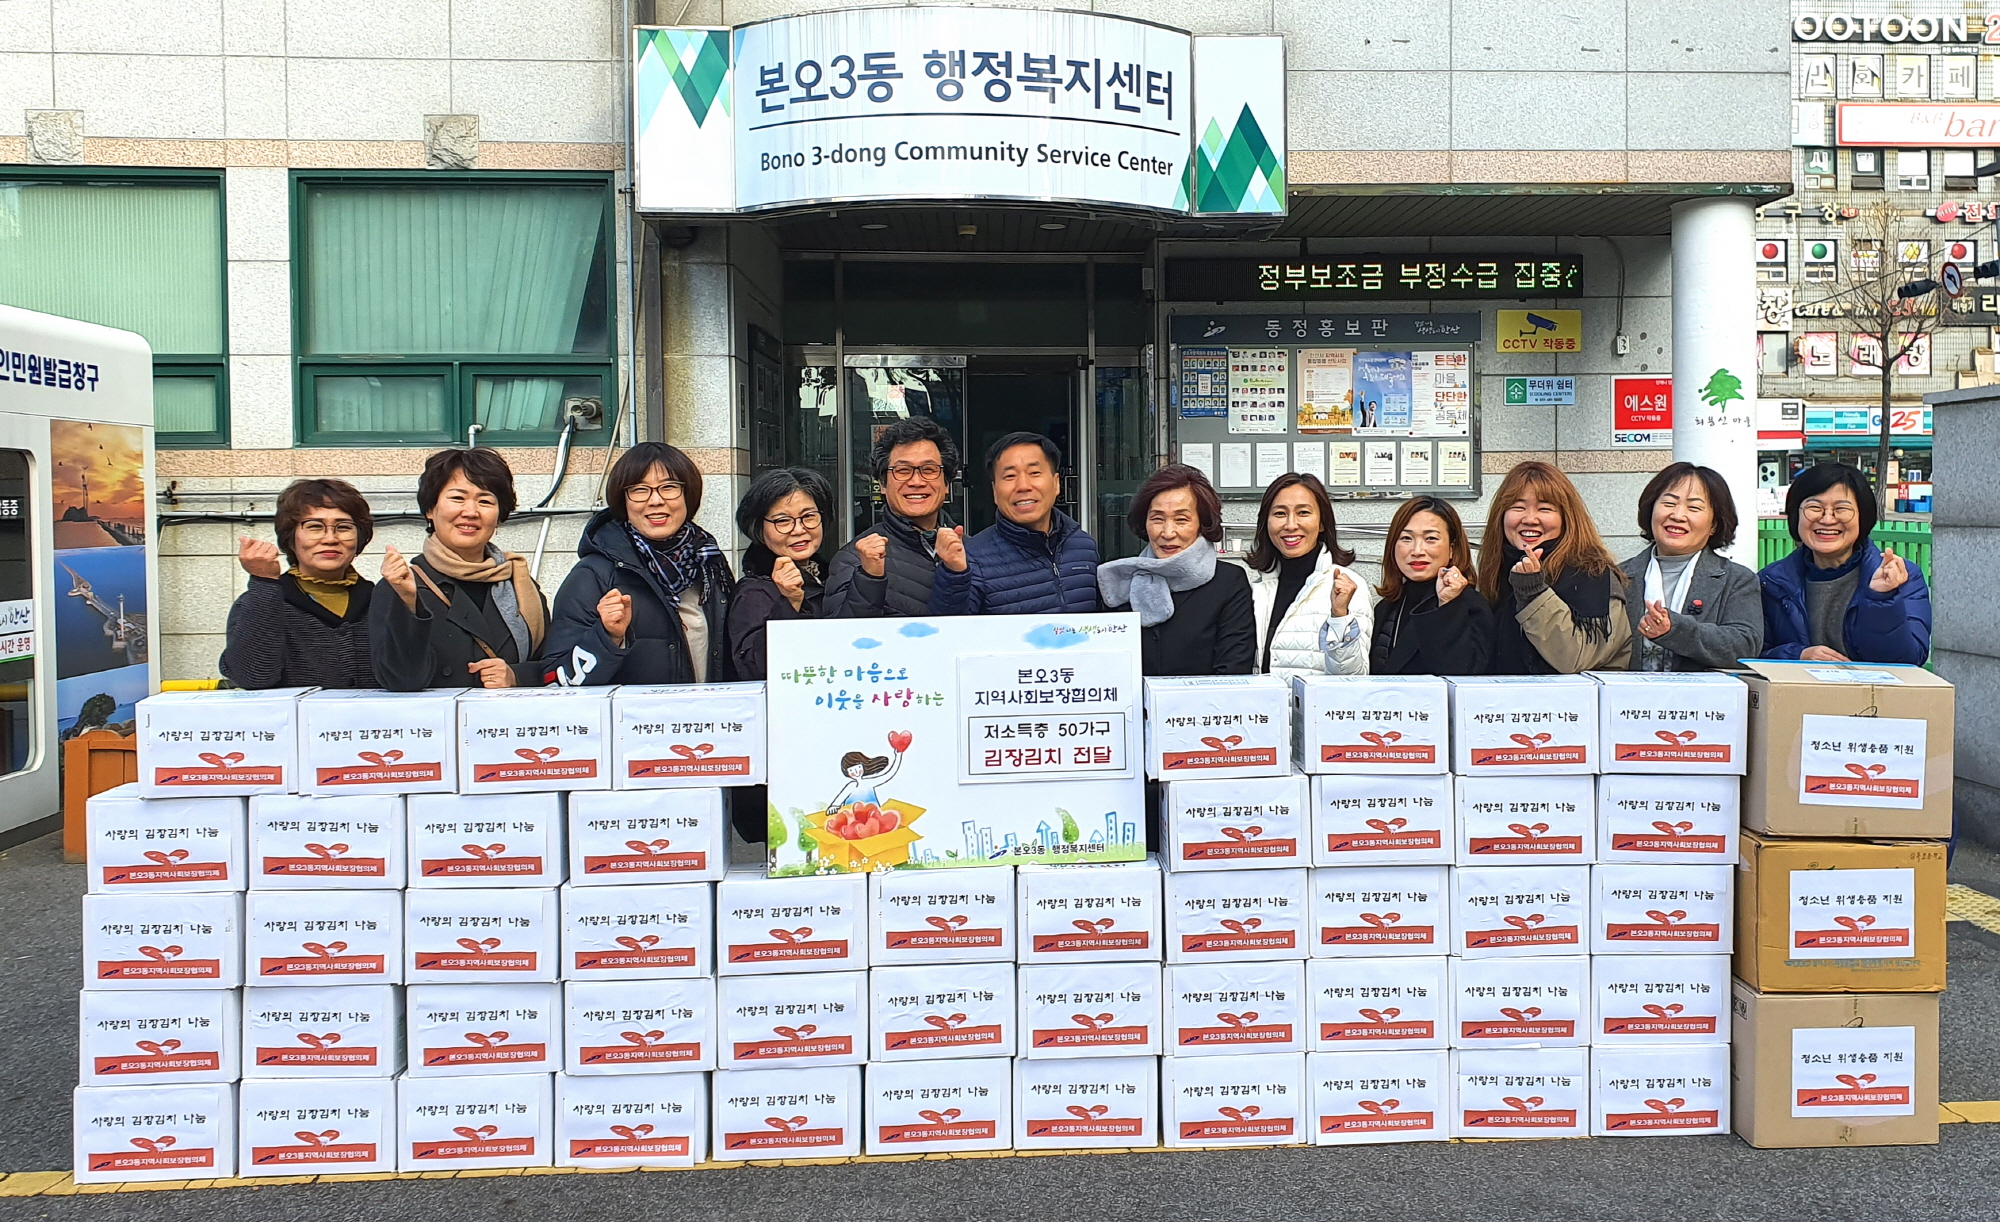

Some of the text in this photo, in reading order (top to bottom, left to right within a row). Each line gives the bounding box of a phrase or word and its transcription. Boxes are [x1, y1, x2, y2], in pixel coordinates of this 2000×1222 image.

[1794, 13, 1967, 42] OOTOON
[755, 48, 1174, 121] 본오3동 행정복지센터
[761, 141, 1173, 176] Bono 3-dong Community Service Center
[1258, 263, 1383, 291] 정부보조금
[1399, 262, 1499, 290] 부정수급
[1264, 319, 1389, 338] 동정홍보판
[1503, 338, 1576, 349] CCTV 작동중
[1529, 379, 1573, 391] 무더위 쉼터
[1435, 391, 1468, 403] 단단한
[1624, 394, 1667, 412] 에스원
[1614, 433, 1650, 443] SECOM
[17, 636, 31, 652] 운영
[781, 661, 909, 686] 따뜻한 마음으로
[1017, 668, 1075, 685] 본오3동
[815, 687, 945, 711] 이웃을 사랑하는
[974, 688, 1118, 706] 지역사회보장협의체
[1165, 714, 1269, 728] 사랑의 김장김치 나눔
[159, 731, 275, 742] 사랑의 김장김치 나눔
[984, 721, 1111, 740] 저소득층 50가구
[1811, 740, 1914, 755] 청소년 위생용품 지원
[984, 745, 1112, 767] 김장김치 전달
[1186, 754, 1270, 765] 본오3동지역사회보장협의체
[181, 772, 275, 783] 본오3동지역사회보장협의체
[1330, 797, 1434, 810] 사랑의 김장김치 나눔
[1617, 800, 1721, 812] 사랑의 김장김치 나눔
[267, 821, 379, 833] 사랑의 김장김치 나눔
[587, 817, 699, 830] 사랑의 김장김치 나눔
[1351, 837, 1434, 847] 본오3동지역사회보장협의체
[1636, 839, 1719, 850] 본오3동지역사회보장협의체
[1013, 841, 1105, 857] 본오3동 행정복지센터
[288, 863, 378, 874] 본오3동지역사회보장협의체
[610, 859, 698, 869] 본오3동지역사회보장협의체
[1036, 896, 1142, 910] 사랑의 김장김치 나눔
[1324, 892, 1428, 903] 사랑의 김장김치 나눔
[1799, 894, 1902, 906] 청소년 위생용품 지원
[732, 905, 841, 919] 사랑의 김장김치 나눔
[420, 916, 530, 927] 사랑의 김장김치 나눔
[101, 924, 212, 935] 사랑의 김장김치 나눔
[1345, 931, 1427, 942] 본오3동지역사회보장협의체
[1057, 938, 1142, 948] 본오3동지역사회보장협의체
[753, 947, 841, 958] 본오3동지역사회보장협의체
[440, 958, 529, 968] 본오3동지역사회보장협의체
[123, 965, 213, 976] 본오3동지역사회보장협의체
[888, 990, 994, 1007] 사랑의 김장김치 나눔
[1323, 986, 1427, 999] 사랑의 김장김치 나눔
[427, 1009, 538, 1022] 사랑의 김장김치 나눔
[909, 1032, 995, 1044] 본오3동지역사회보장협의체
[1344, 1027, 1427, 1037] 본오3동지역사회보장협의체
[448, 1050, 538, 1061] 본오3동지역사회보장협의체
[1801, 1051, 1903, 1064] 청소년 위생용품 지원
[1183, 1084, 1286, 1097] 사랑의 김장김치 나눔
[92, 1114, 206, 1127] 사랑의 김장김치 나눔
[1203, 1124, 1287, 1135] 본오3동지역사회보장협의체
[114, 1155, 207, 1167] 본오3동지역사회보장협의체
